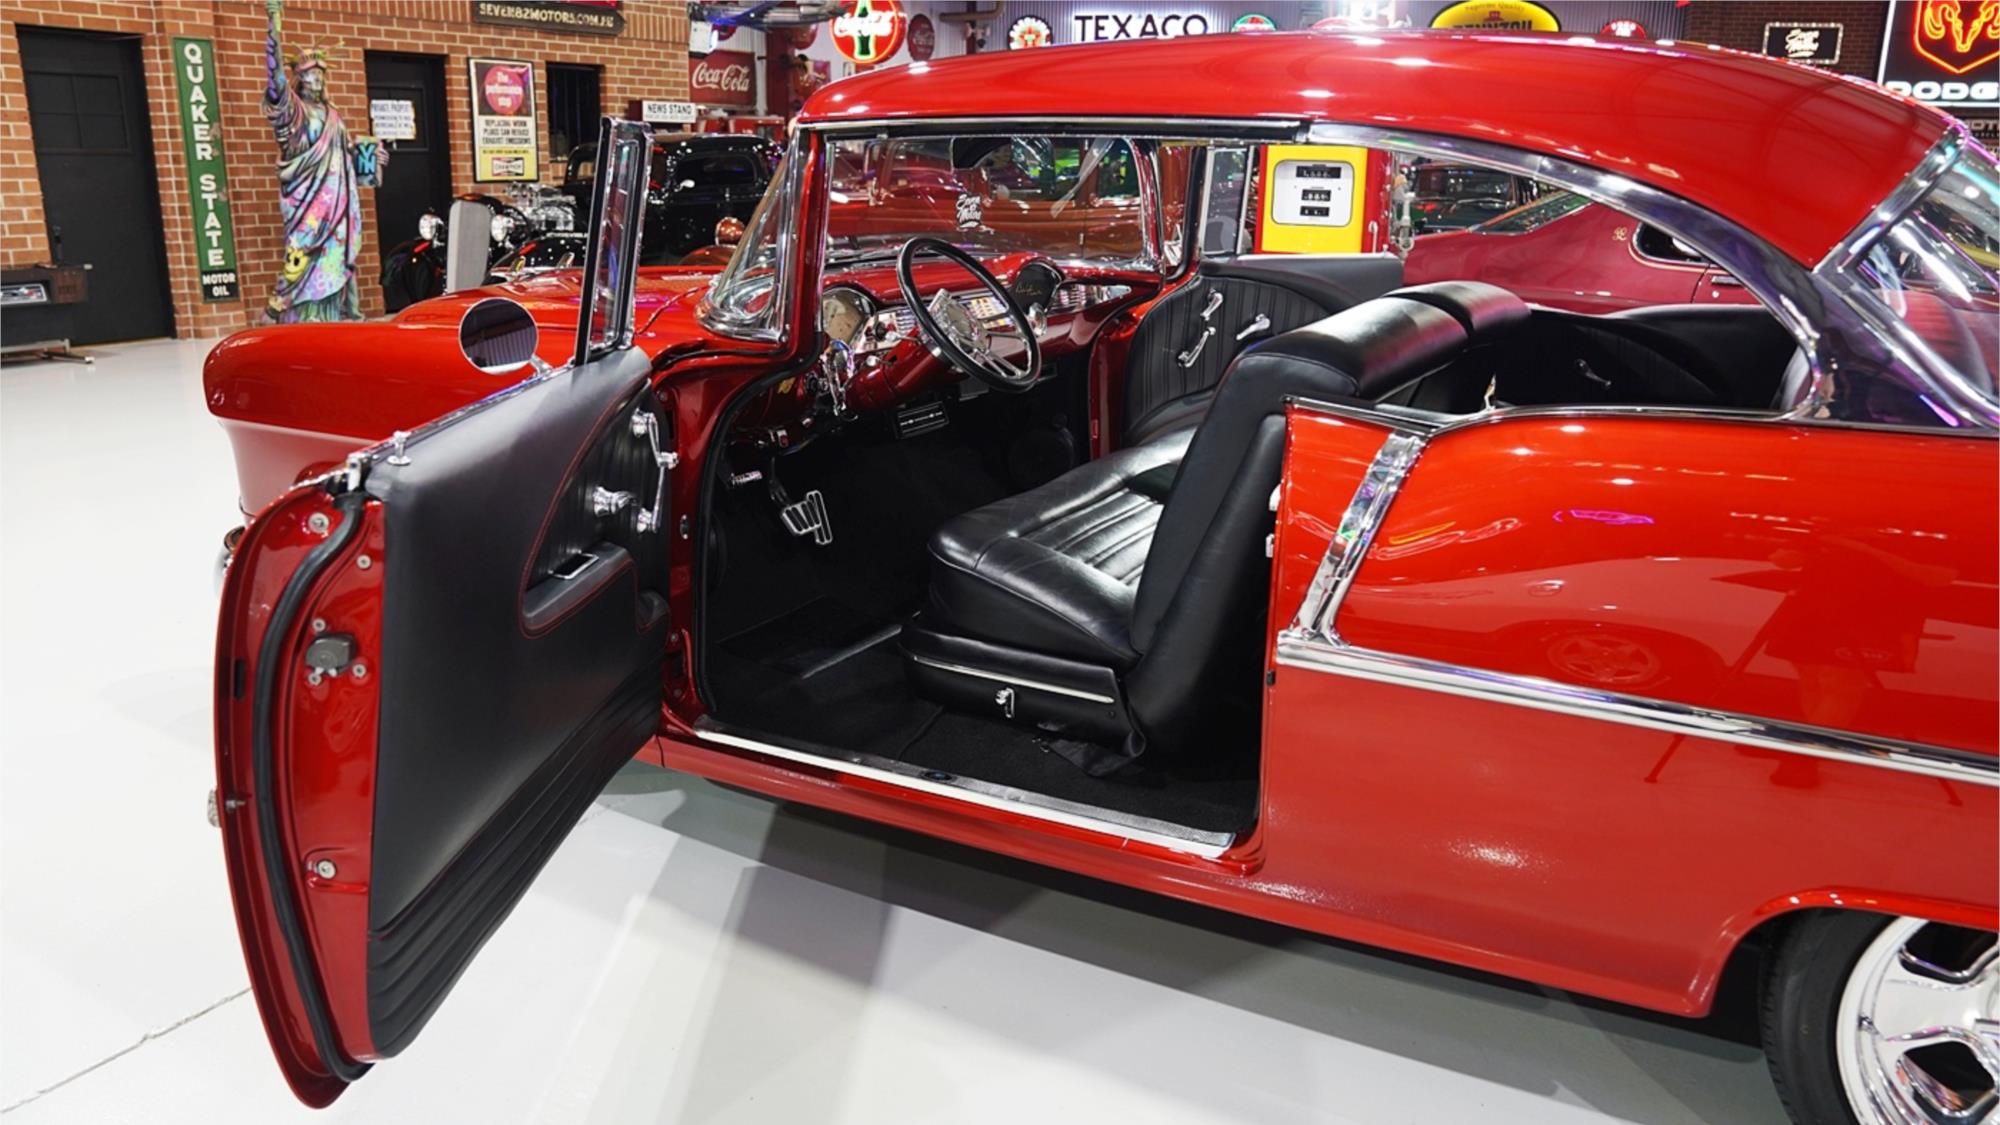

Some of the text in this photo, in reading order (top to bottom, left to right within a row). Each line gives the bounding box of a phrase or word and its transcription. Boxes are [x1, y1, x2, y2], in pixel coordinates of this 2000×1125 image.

[1074, 14, 1208, 41] TEXACO
[647, 103, 693, 114] NEWS STAND
[184, 43, 225, 266] QUAKER STATE
[202, 273, 236, 285] MOTOR
[212, 286, 230, 297] OIL
